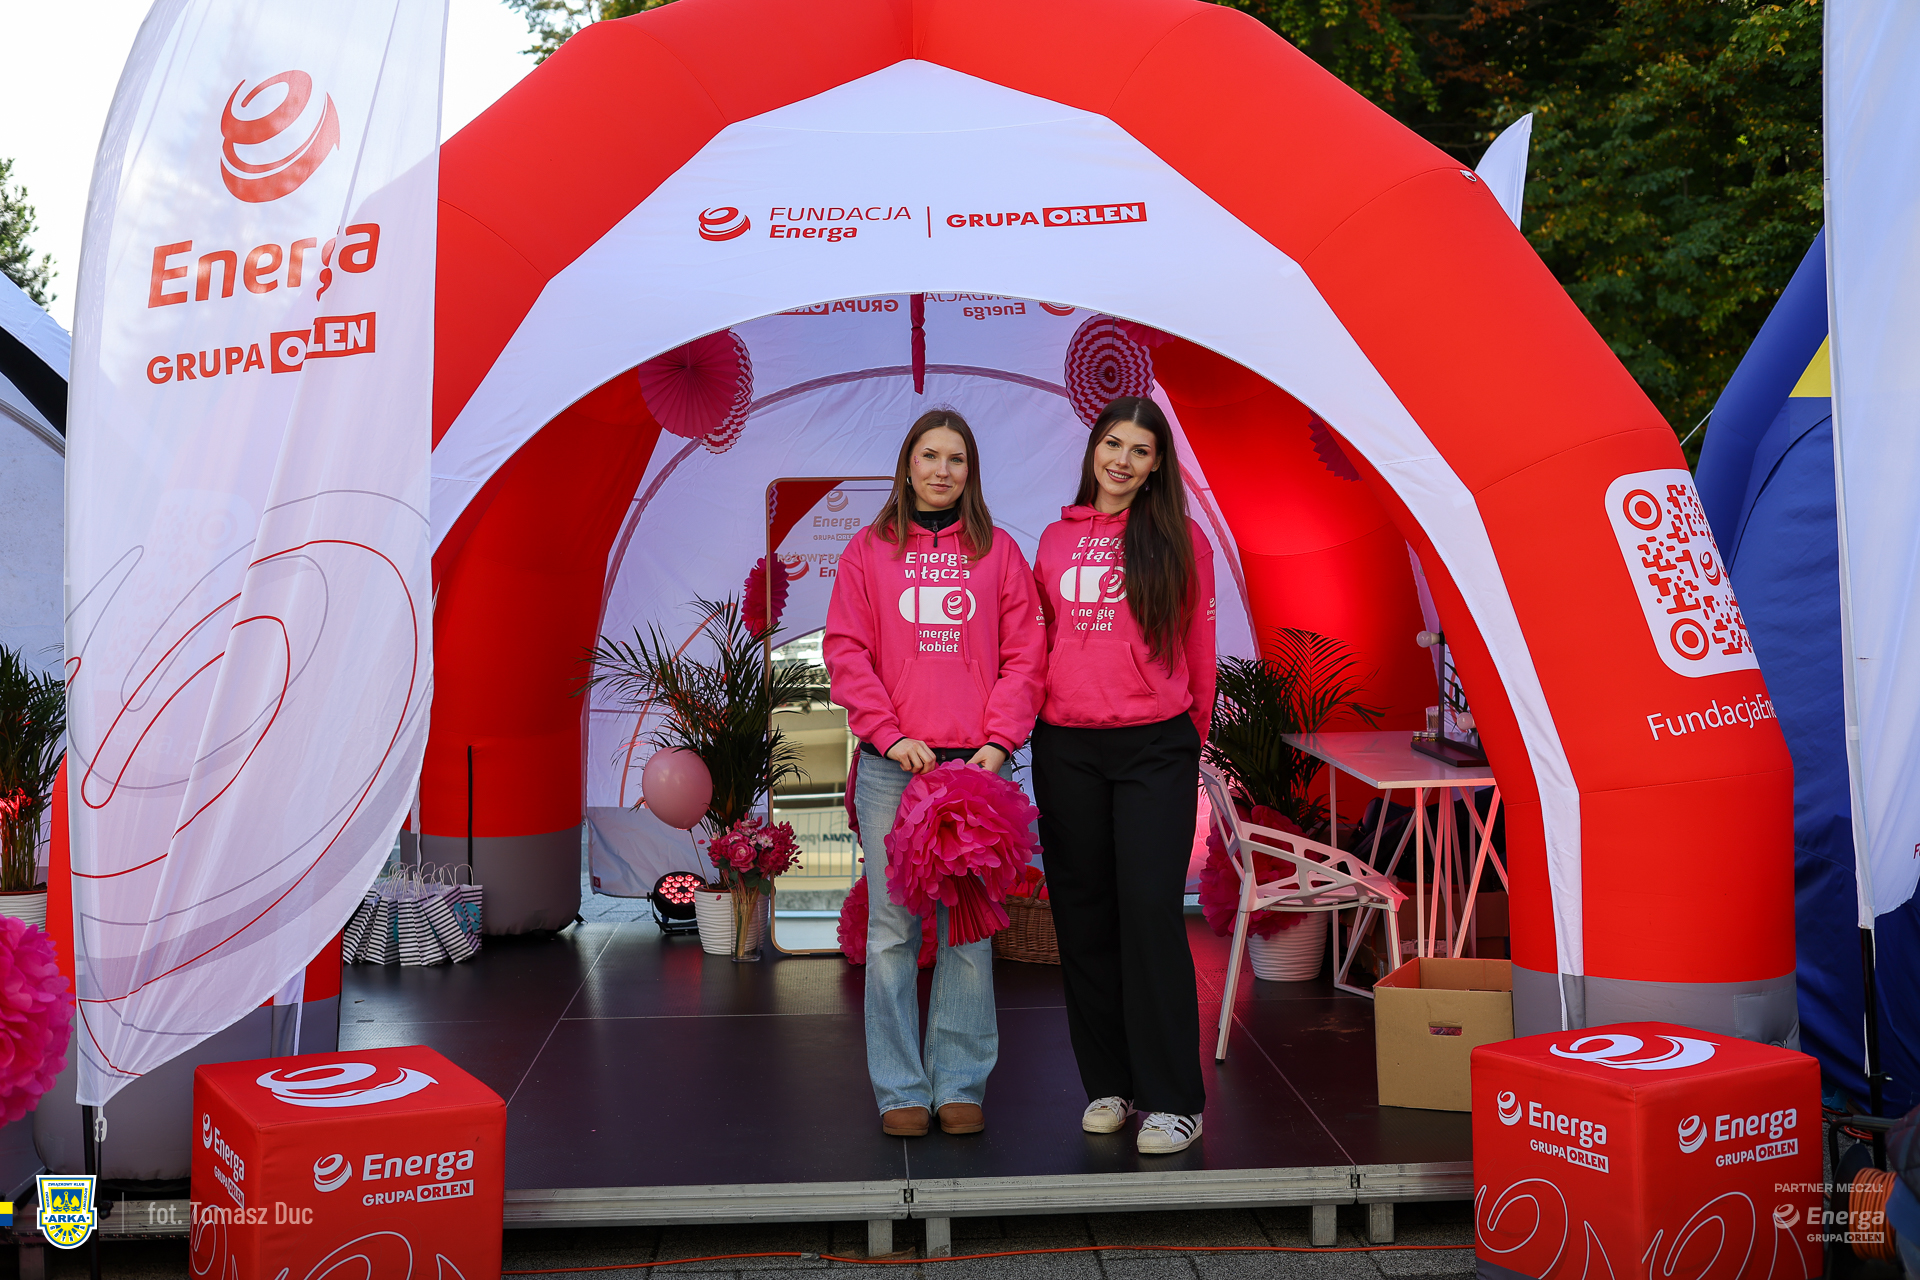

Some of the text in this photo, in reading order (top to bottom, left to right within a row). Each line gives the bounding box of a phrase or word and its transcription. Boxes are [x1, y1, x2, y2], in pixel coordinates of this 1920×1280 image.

[769, 206, 912, 221] FUNDACJA
[946, 204, 1144, 228] GRUPA ORLEN
[769, 224, 858, 243] Energa
[146, 316, 371, 384] GRUPA OLEN
[812, 516, 860, 530] Energa
[904, 566, 971, 582] włącza
[1071, 607, 1115, 620] negię
[919, 641, 959, 652] kobiet
[1528, 1101, 1607, 1148] Energa
[1715, 1108, 1797, 1142] Energa
[214, 1126, 245, 1182] Energa
[362, 1149, 474, 1181] Energa
[1529, 1139, 1607, 1171] GRUPA ORLEN
[1715, 1140, 1797, 1167] GRUPA ORLEN
[362, 1181, 472, 1207] GRUPA ORLEN
